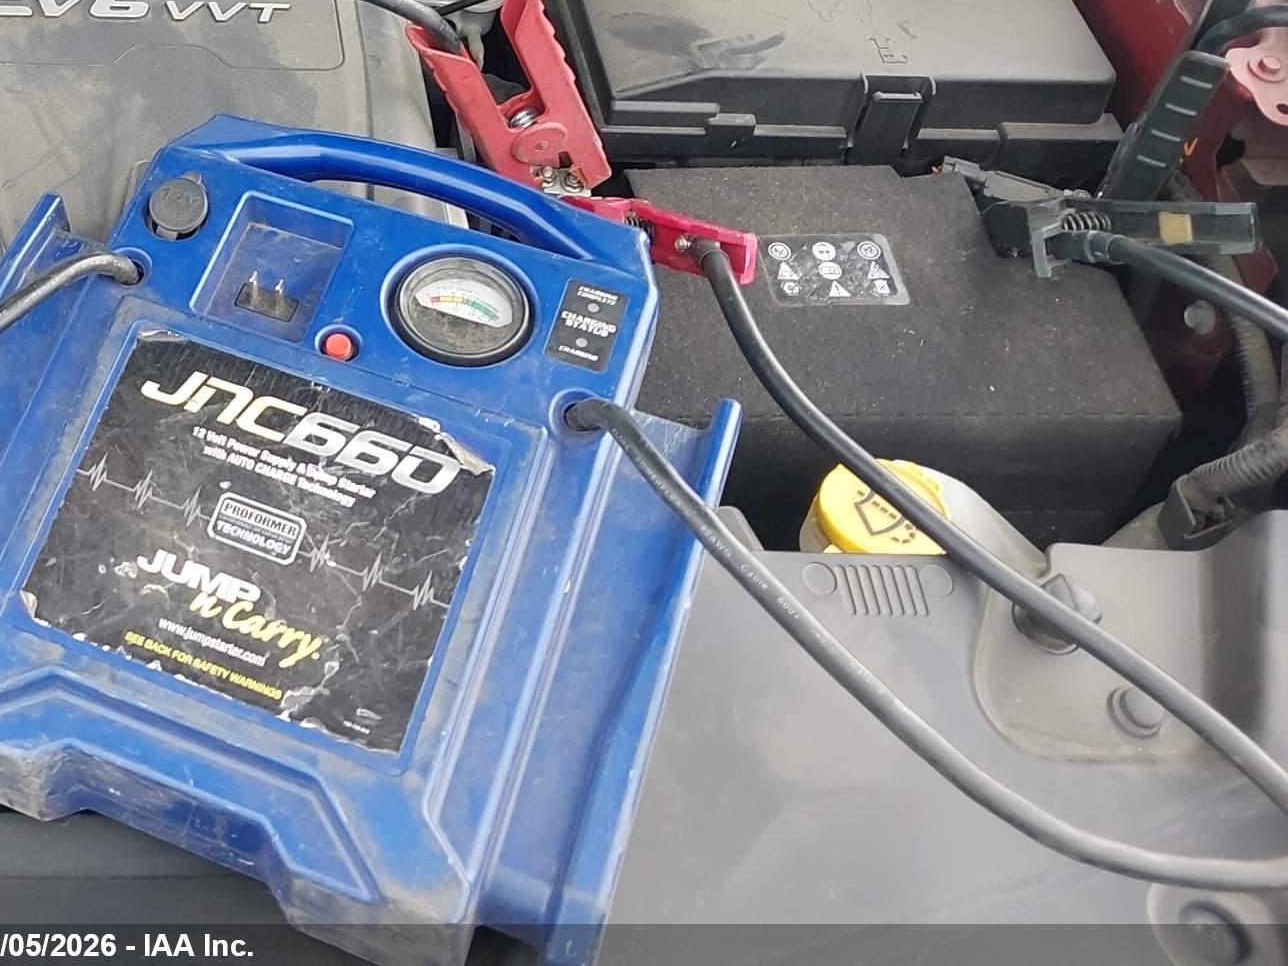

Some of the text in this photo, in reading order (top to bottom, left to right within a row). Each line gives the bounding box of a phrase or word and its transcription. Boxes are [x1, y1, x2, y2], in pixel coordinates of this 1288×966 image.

[165, 0, 291, 24] VVT
[203, 444, 356, 508] with AUTO CHARGE Technology
[206, 430, 228, 446] Volt
[226, 437, 261, 457] Power
[260, 449, 297, 472] Supply
[296, 462, 307, 474] &
[337, 476, 377, 499] Starter
[216, 520, 292, 555] TECHNOLOGY
[223, 502, 298, 537] PROFORMER
[137, 549, 261, 603] JUMP
[124, 631, 282, 701] SEE BACK FOR SAFETY WARNINGS
[158, 618, 267, 666] www.jumpstarter.com
